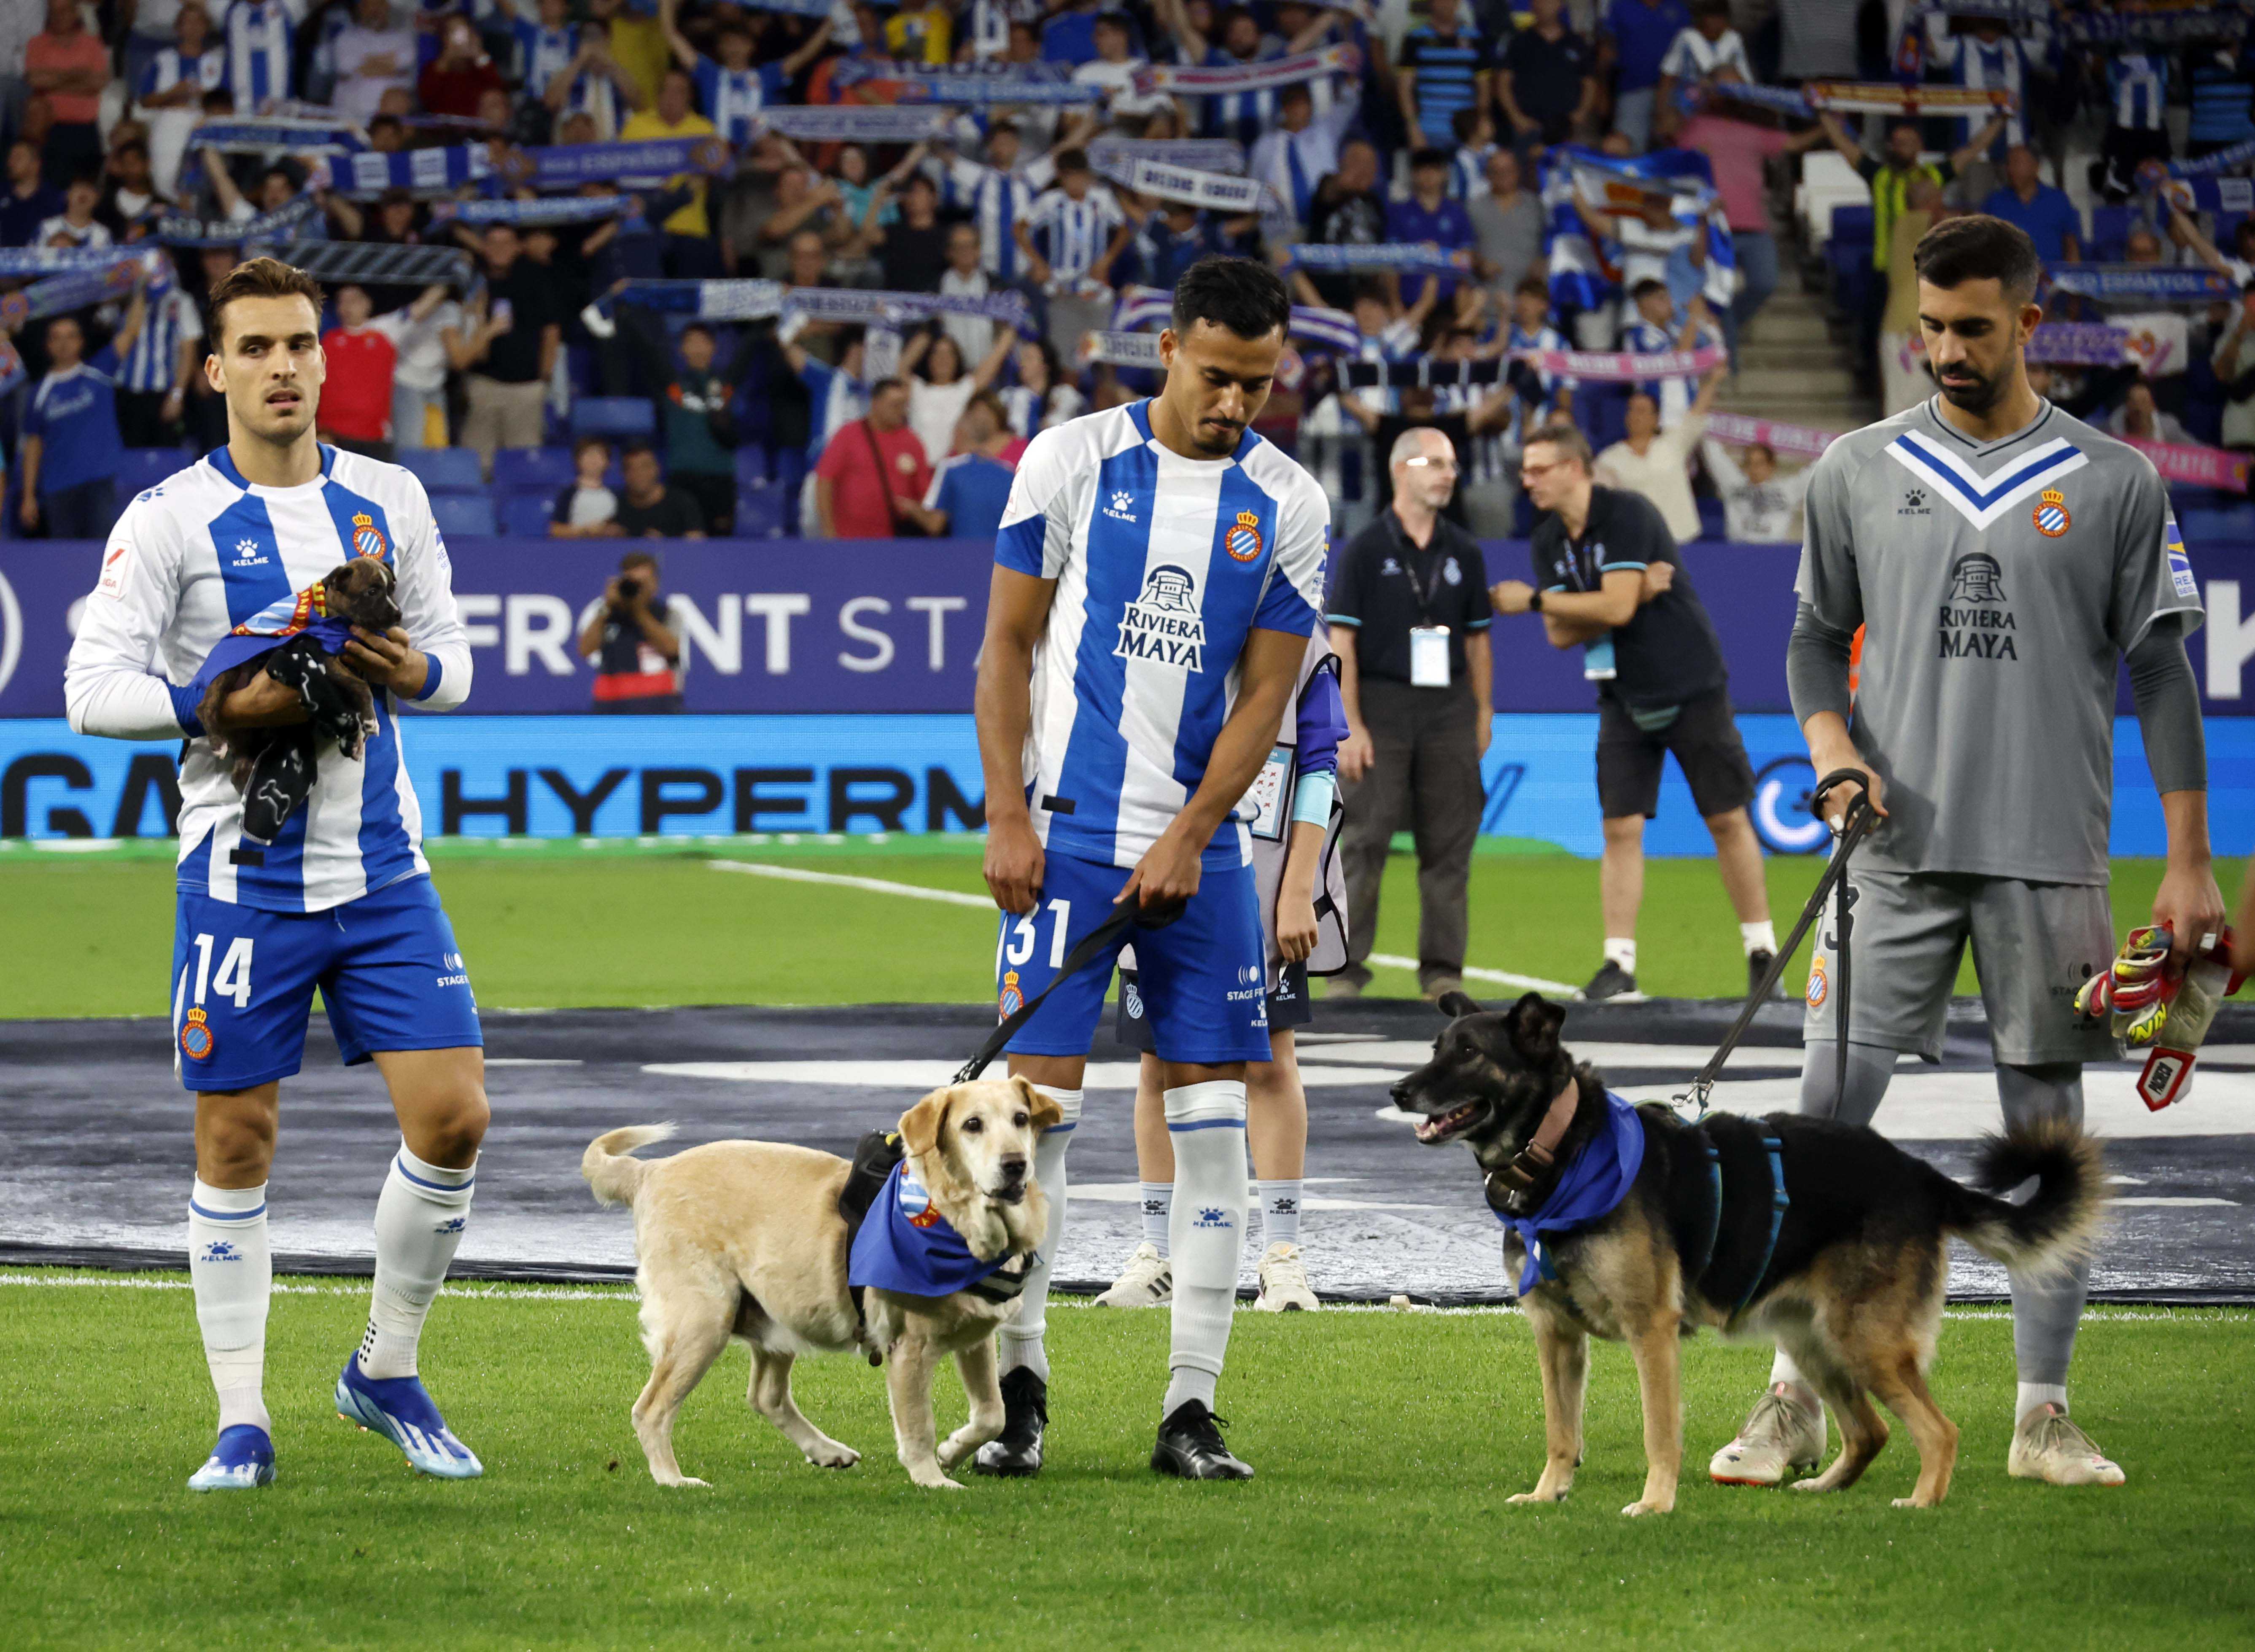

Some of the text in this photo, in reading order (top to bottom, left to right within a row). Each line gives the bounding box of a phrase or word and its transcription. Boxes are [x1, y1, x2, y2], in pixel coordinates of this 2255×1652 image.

[1102, 507, 1137, 522] KELME
[233, 556, 269, 567] KELME
[101, 578, 116, 589] IGA
[2174, 576, 2193, 586] RE
[2177, 586, 2196, 595] SEG
[1125, 607, 1201, 641] RIVIERA
[1939, 606, 2016, 630] RIVIERA
[837, 595, 985, 673] ST
[1118, 632, 1200, 671] MAYA
[1939, 631, 2018, 661] MAYA
[1006, 899, 1071, 969] 31
[194, 933, 254, 1008] 14
[436, 975, 465, 987] STAGE
[1227, 989, 1253, 1001] STAGE
[1276, 993, 1296, 1001] KELME
[201, 1254, 242, 1262] KELME
